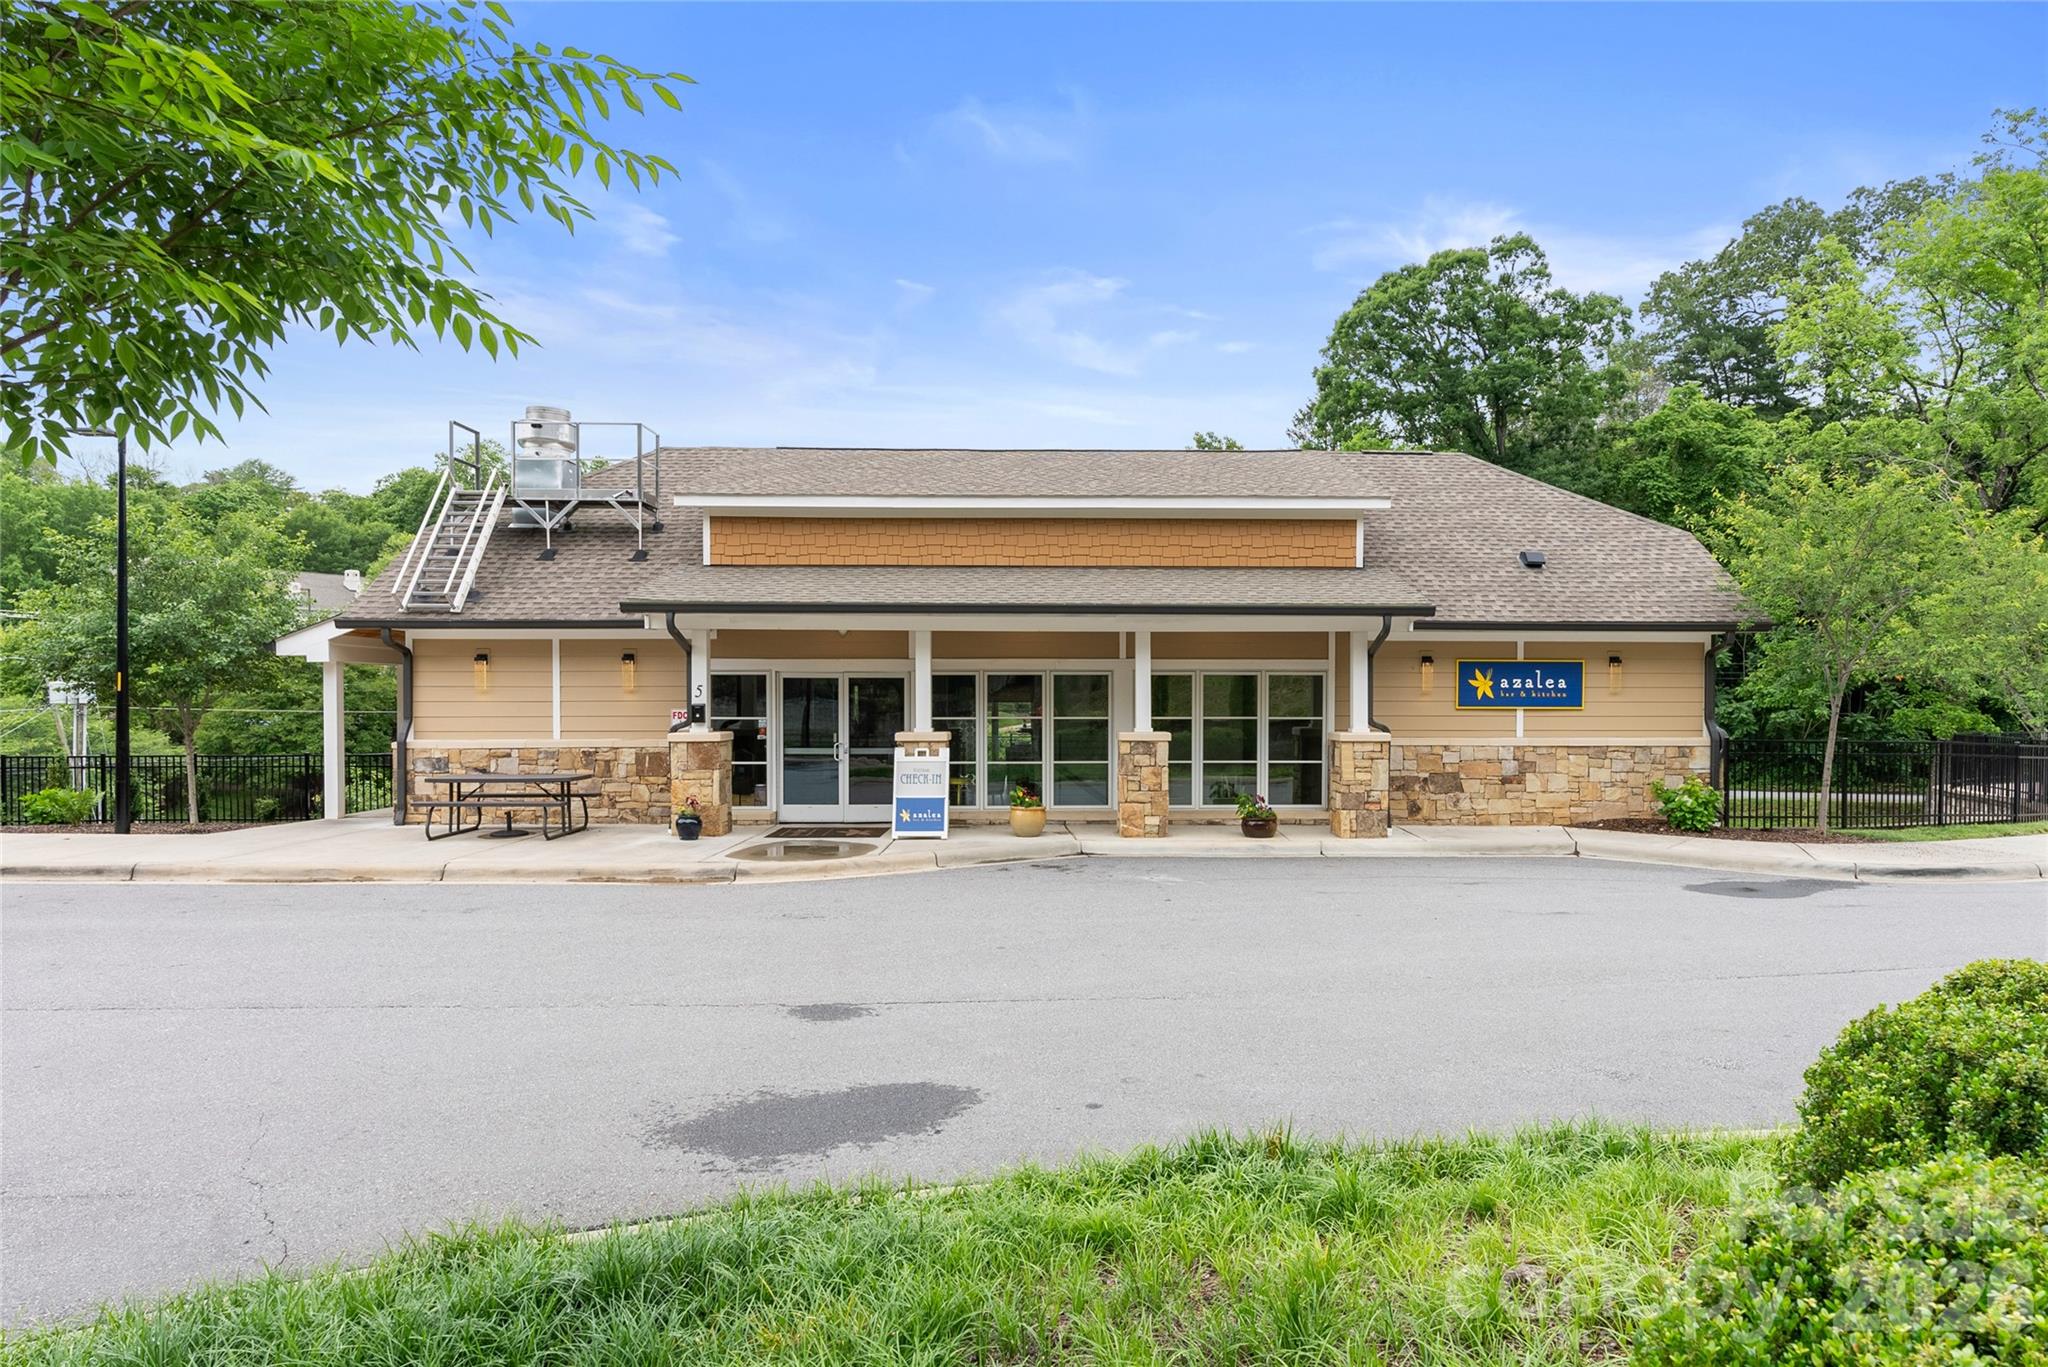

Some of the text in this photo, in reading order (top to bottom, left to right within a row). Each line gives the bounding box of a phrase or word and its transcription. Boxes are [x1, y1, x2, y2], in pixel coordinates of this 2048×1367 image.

[1500, 670, 1567, 689] azalea
[694, 685, 703, 698] 5
[1500, 690, 1514, 698] bar
[1531, 690, 1567, 698] kitchen
[900, 773, 942, 784] CHECK-IN
